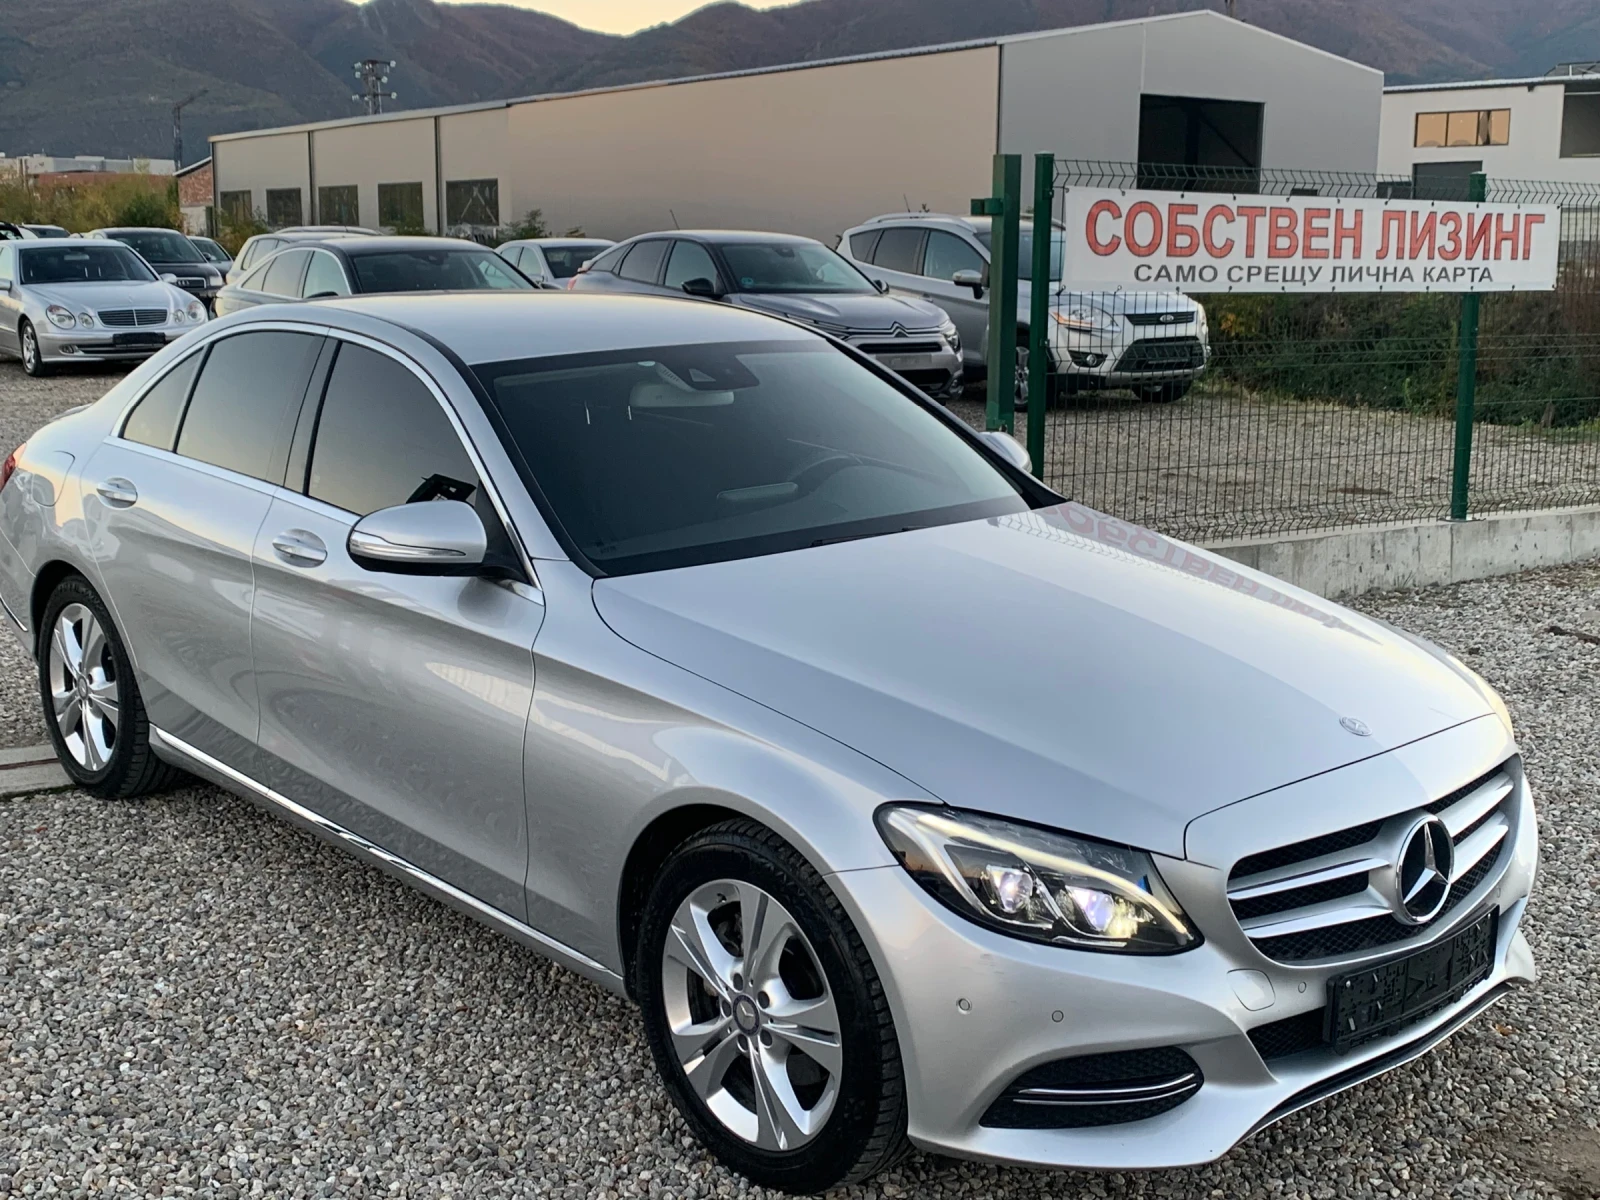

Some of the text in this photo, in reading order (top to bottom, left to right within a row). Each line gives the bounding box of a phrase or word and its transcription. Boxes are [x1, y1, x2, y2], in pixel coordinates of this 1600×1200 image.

[1085, 199, 1545, 260] СОБСТВЕН ЛИЗИНГ
[1133, 264, 1493, 284] САМО СРЕЩУ ЛИЧНА КАРТА
